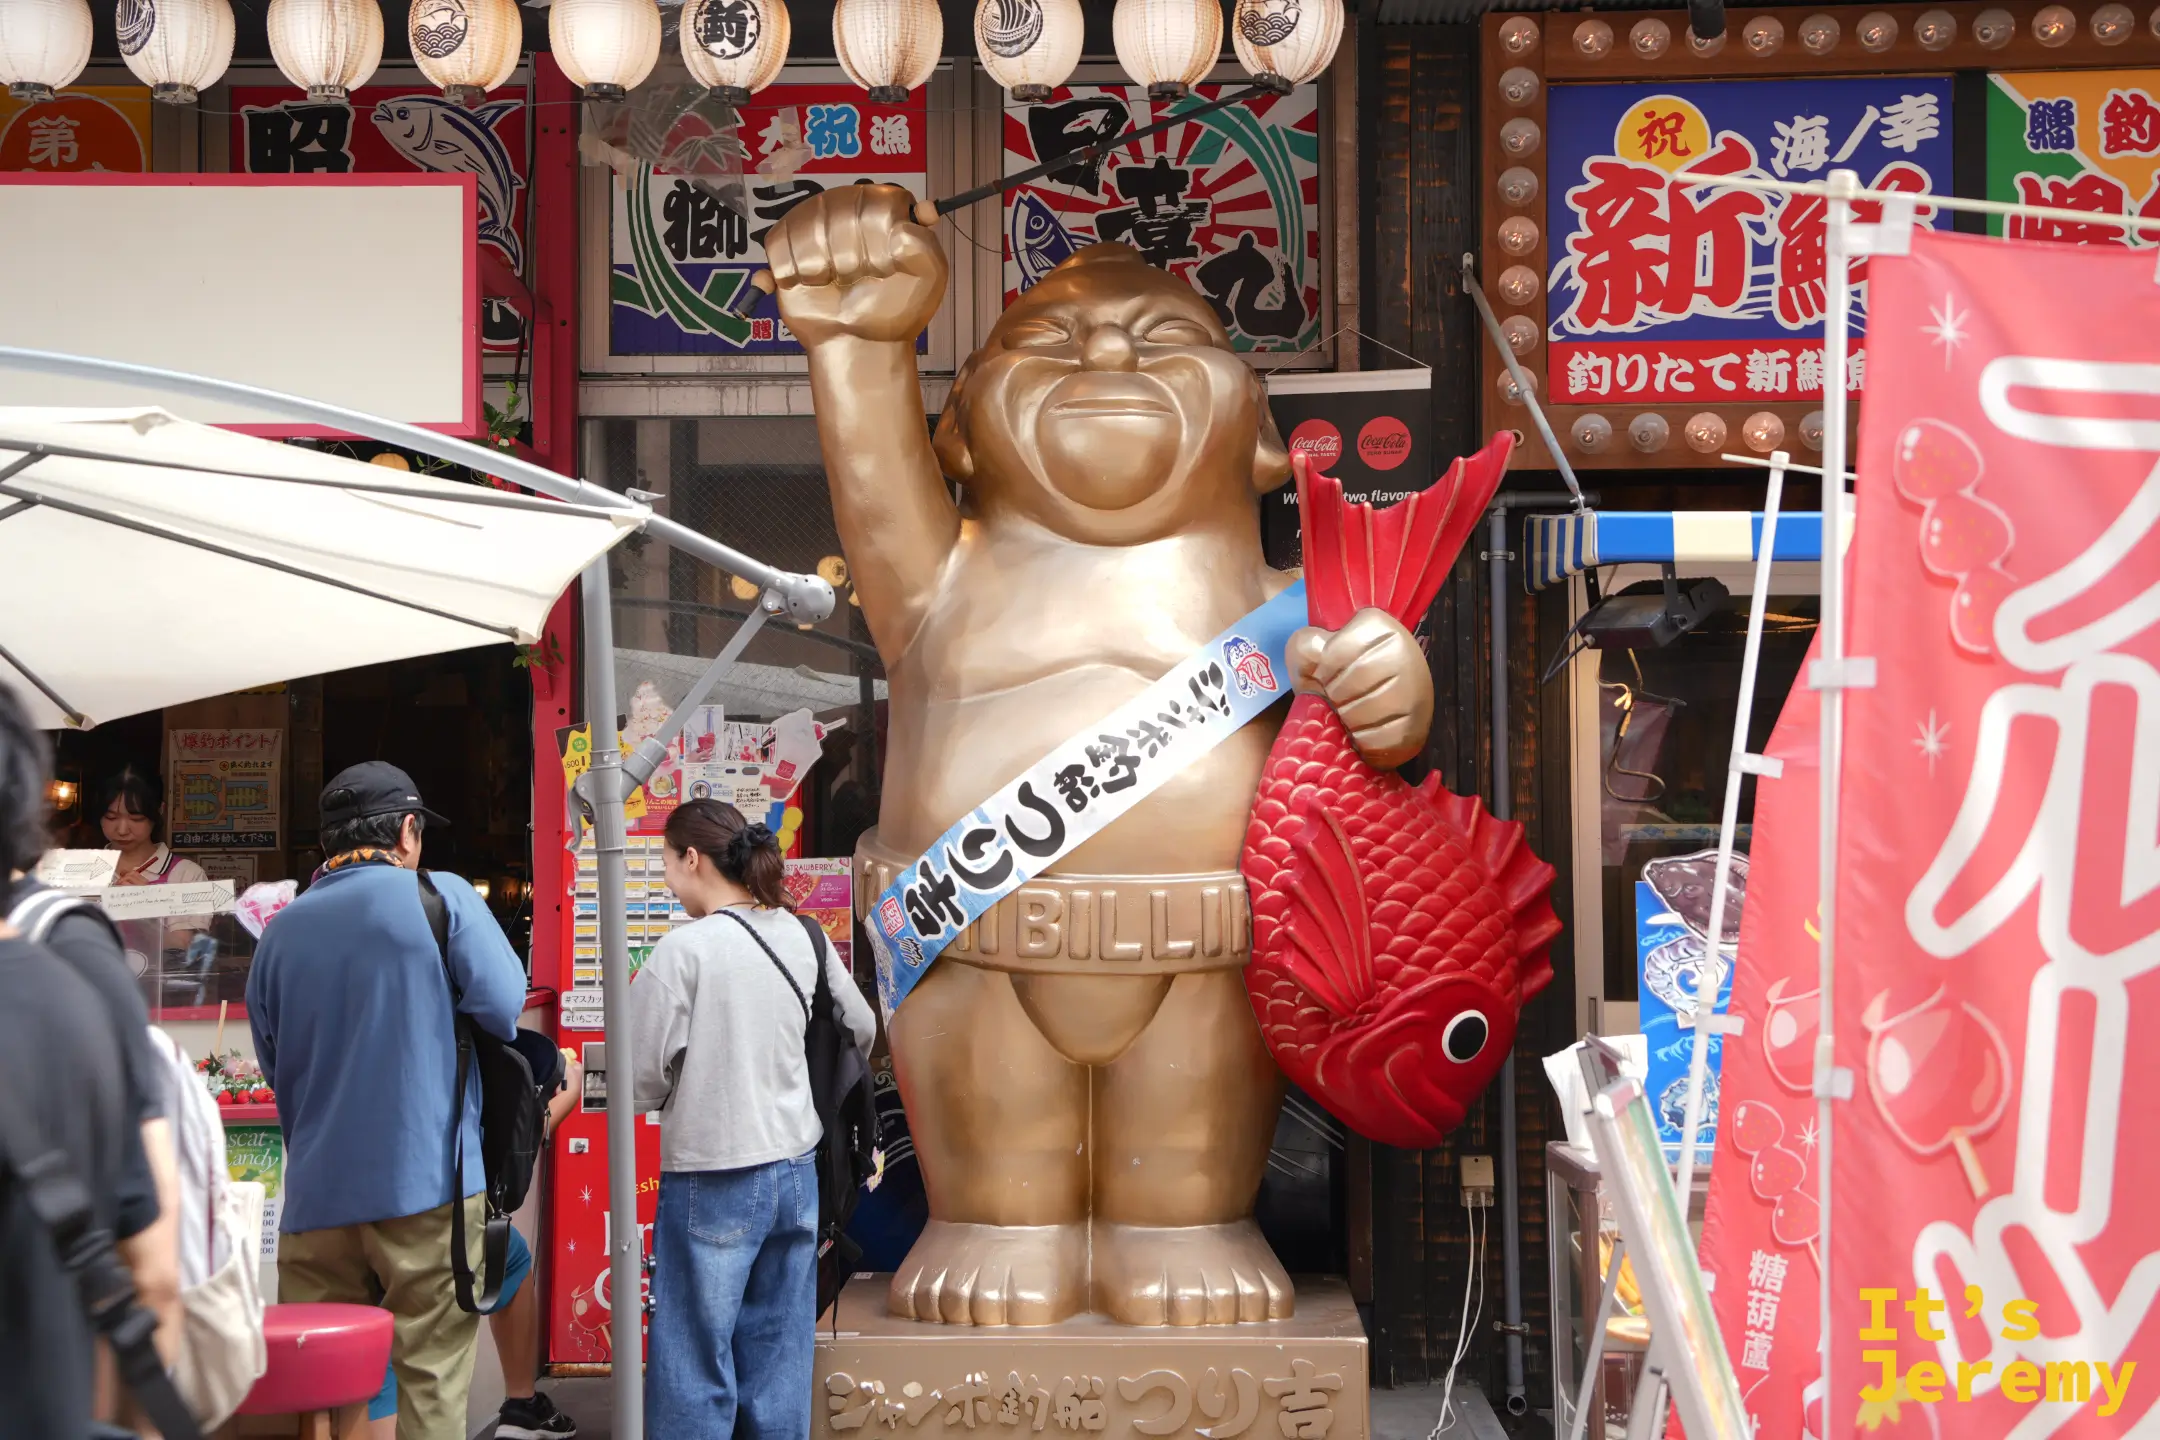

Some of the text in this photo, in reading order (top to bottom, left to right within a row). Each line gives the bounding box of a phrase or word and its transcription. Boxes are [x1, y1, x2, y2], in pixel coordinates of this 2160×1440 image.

[27, 114, 81, 168] 第
[1637, 109, 1692, 160] 祝
[1769, 92, 1941, 178] 海ノ幸
[786, 863, 833, 873] STRAWBERRY
[1740, 1249, 1789, 1372] 糖葫蘆
